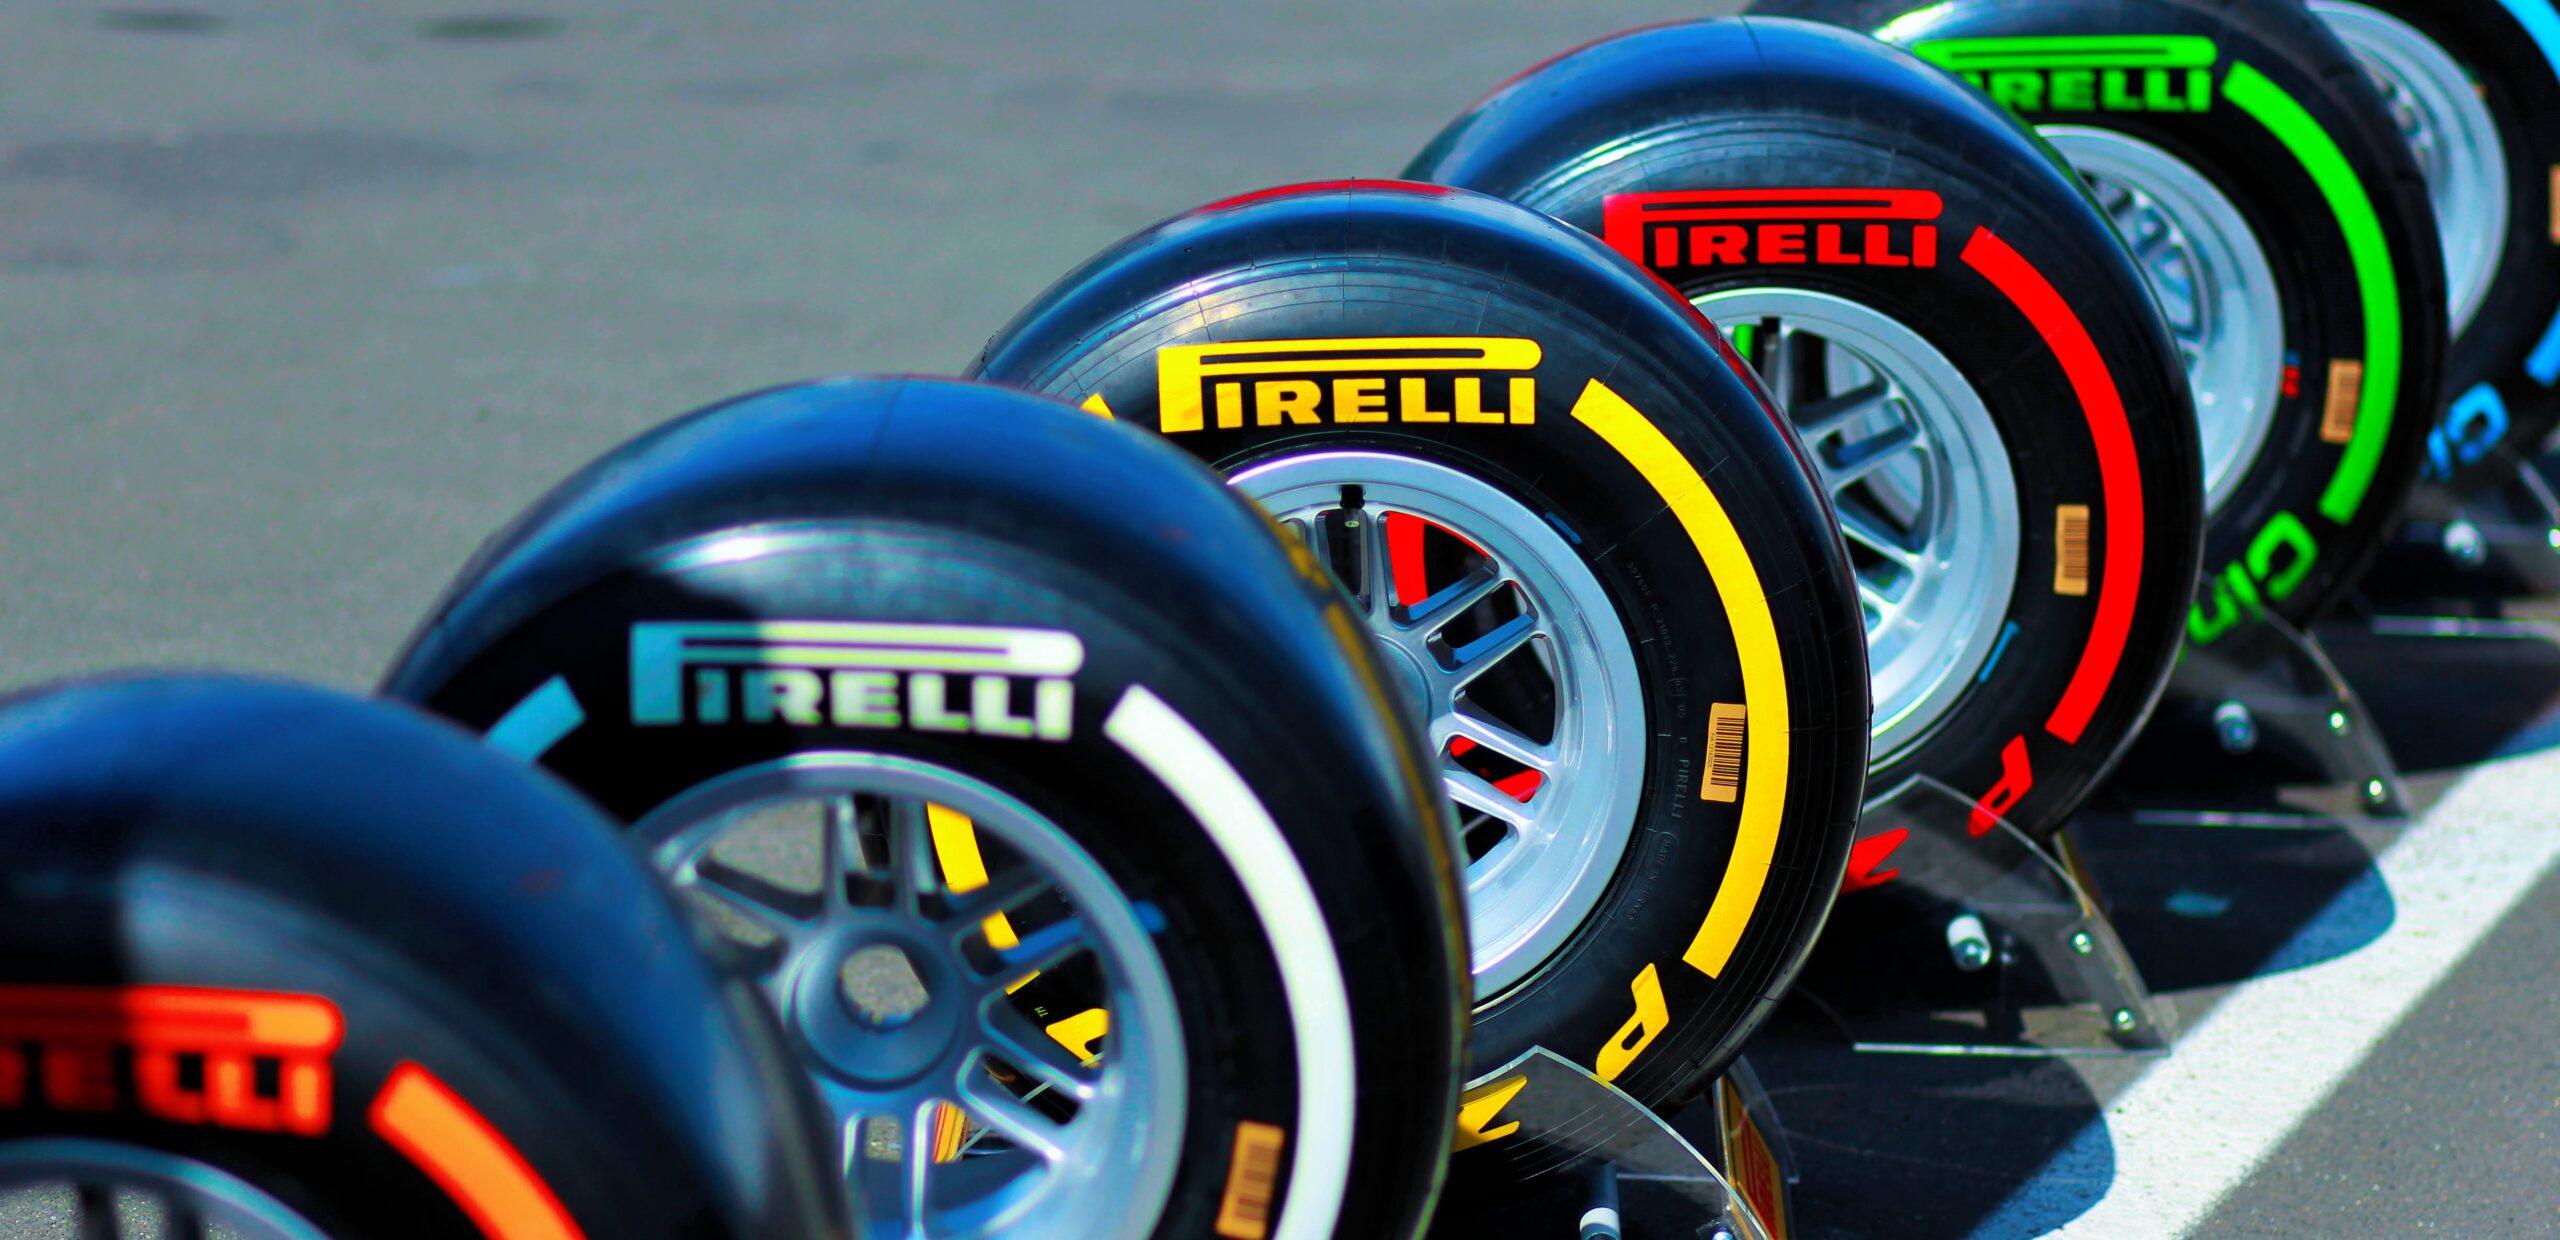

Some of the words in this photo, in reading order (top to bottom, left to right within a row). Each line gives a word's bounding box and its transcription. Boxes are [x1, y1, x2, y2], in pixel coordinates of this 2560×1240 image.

[1911, 35, 2217, 111] PRELLI
[1602, 188, 1944, 270] PIRELLI
[1157, 336, 1542, 433] PIRELLI
[631, 620, 1085, 740] PIRELLI
